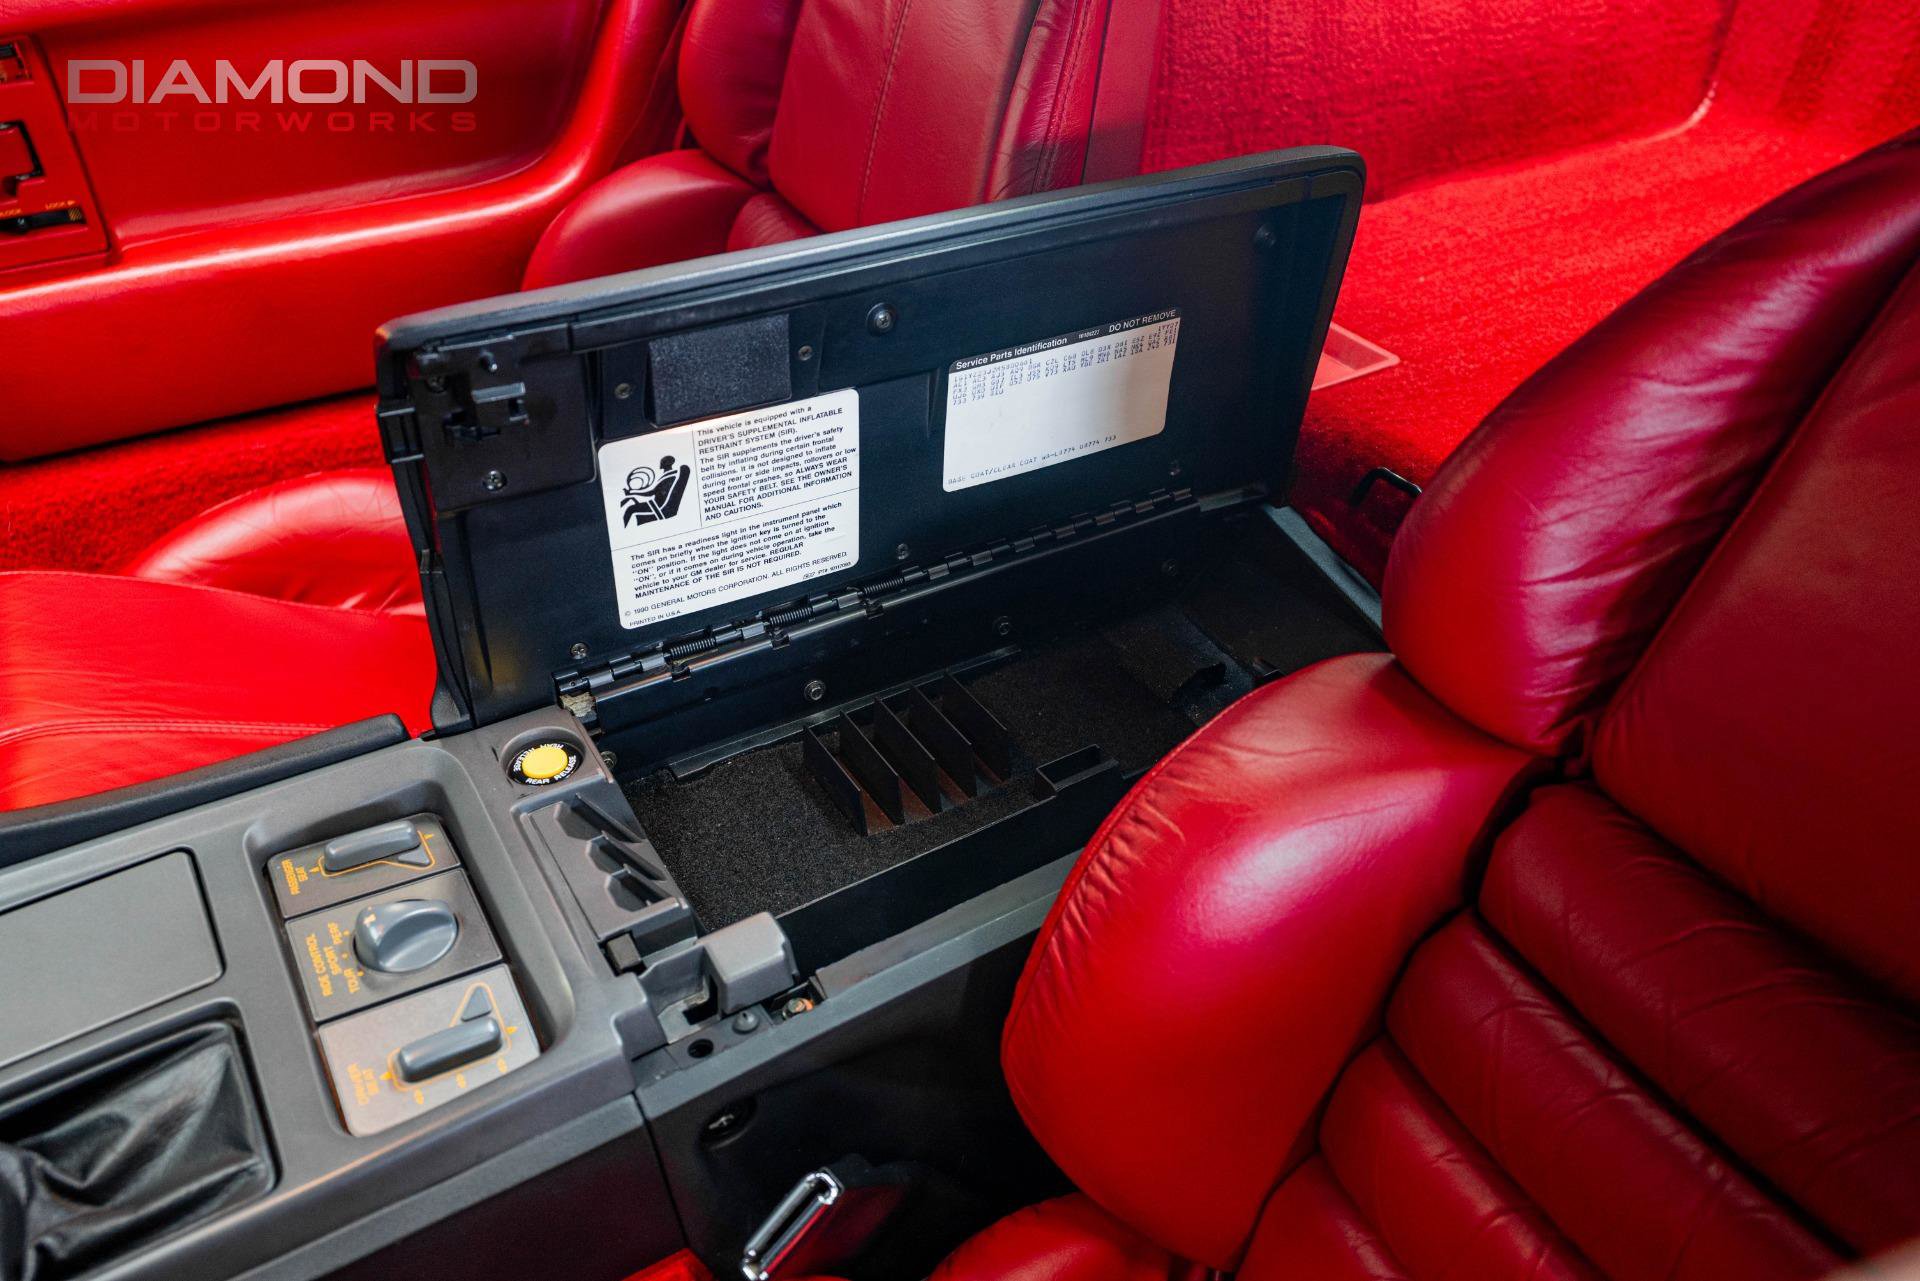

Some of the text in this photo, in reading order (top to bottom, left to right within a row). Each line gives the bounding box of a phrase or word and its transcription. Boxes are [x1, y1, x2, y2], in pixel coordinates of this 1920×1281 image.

[1109, 310, 1176, 332] DO NOT REMOVE
[956, 338, 1067, 370] Service Parts Identification
[698, 407, 842, 446] DRIVER'S SUPPLEMENTAL INFLATABLE
[715, 422, 742, 432] vehicle
[753, 411, 787, 423] equipped
[698, 427, 797, 454] RESTRAINT SYSTEM (SIR).
[728, 455, 758, 466] inflating
[760, 449, 783, 458] during
[785, 442, 809, 452] certain
[812, 435, 834, 446] frontal
[732, 442, 778, 457] supplements
[794, 431, 820, 442] driver's
[822, 426, 843, 435] safety
[770, 451, 803, 464] designed
[815, 444, 836, 453] inflate
[702, 479, 725, 489] during
[804, 453, 832, 464] rollovers
[703, 486, 724, 497] speed
[727, 480, 750, 491] frontal
[795, 462, 823, 474] ALWAYS
[825, 456, 847, 466] WEAR
[703, 495, 724, 505] YOUR
[727, 487, 756, 499] SAFETY
[780, 477, 794, 486] SEE
[797, 473, 811, 481] THE
[813, 464, 847, 477] OWNER'S
[704, 471, 851, 513] MANUAL FOR ADDITIONAL INFORMATION
[684, 534, 719, 546] readiness
[721, 529, 737, 537] light
[762, 513, 799, 526] instrument
[801, 507, 820, 517] panel
[822, 502, 841, 511] which
[705, 501, 763, 520] AND CAUTIONS.
[631, 559, 655, 568] comes
[669, 549, 692, 558] briefly
[695, 543, 714, 552] when
[730, 532, 757, 543] ignition
[781, 518, 803, 529] turned
[711, 547, 727, 555] light
[762, 533, 781, 542] come
[803, 520, 828, 532] ignition
[634, 581, 659, 591] vehicle
[671, 573, 687, 582] your
[704, 563, 726, 572] dealer
[769, 541, 803, 555] REGULAR
[683, 561, 707, 570] comes
[720, 551, 743, 561] during
[745, 544, 770, 554] vehicle
[635, 579, 689, 598] MAINTENANCE
[705, 571, 719, 580] THE
[746, 560, 761, 569] NOT
[650, 596, 684, 609] GENERAL
[686, 587, 716, 600] MOTORS
[785, 561, 810, 572] RIGHTS
[629, 616, 656, 626] PRINTED
[554, 755, 576, 780] RELEASE
[306, 934, 326, 974] CONTROL
[344, 968, 360, 993] TOUR
